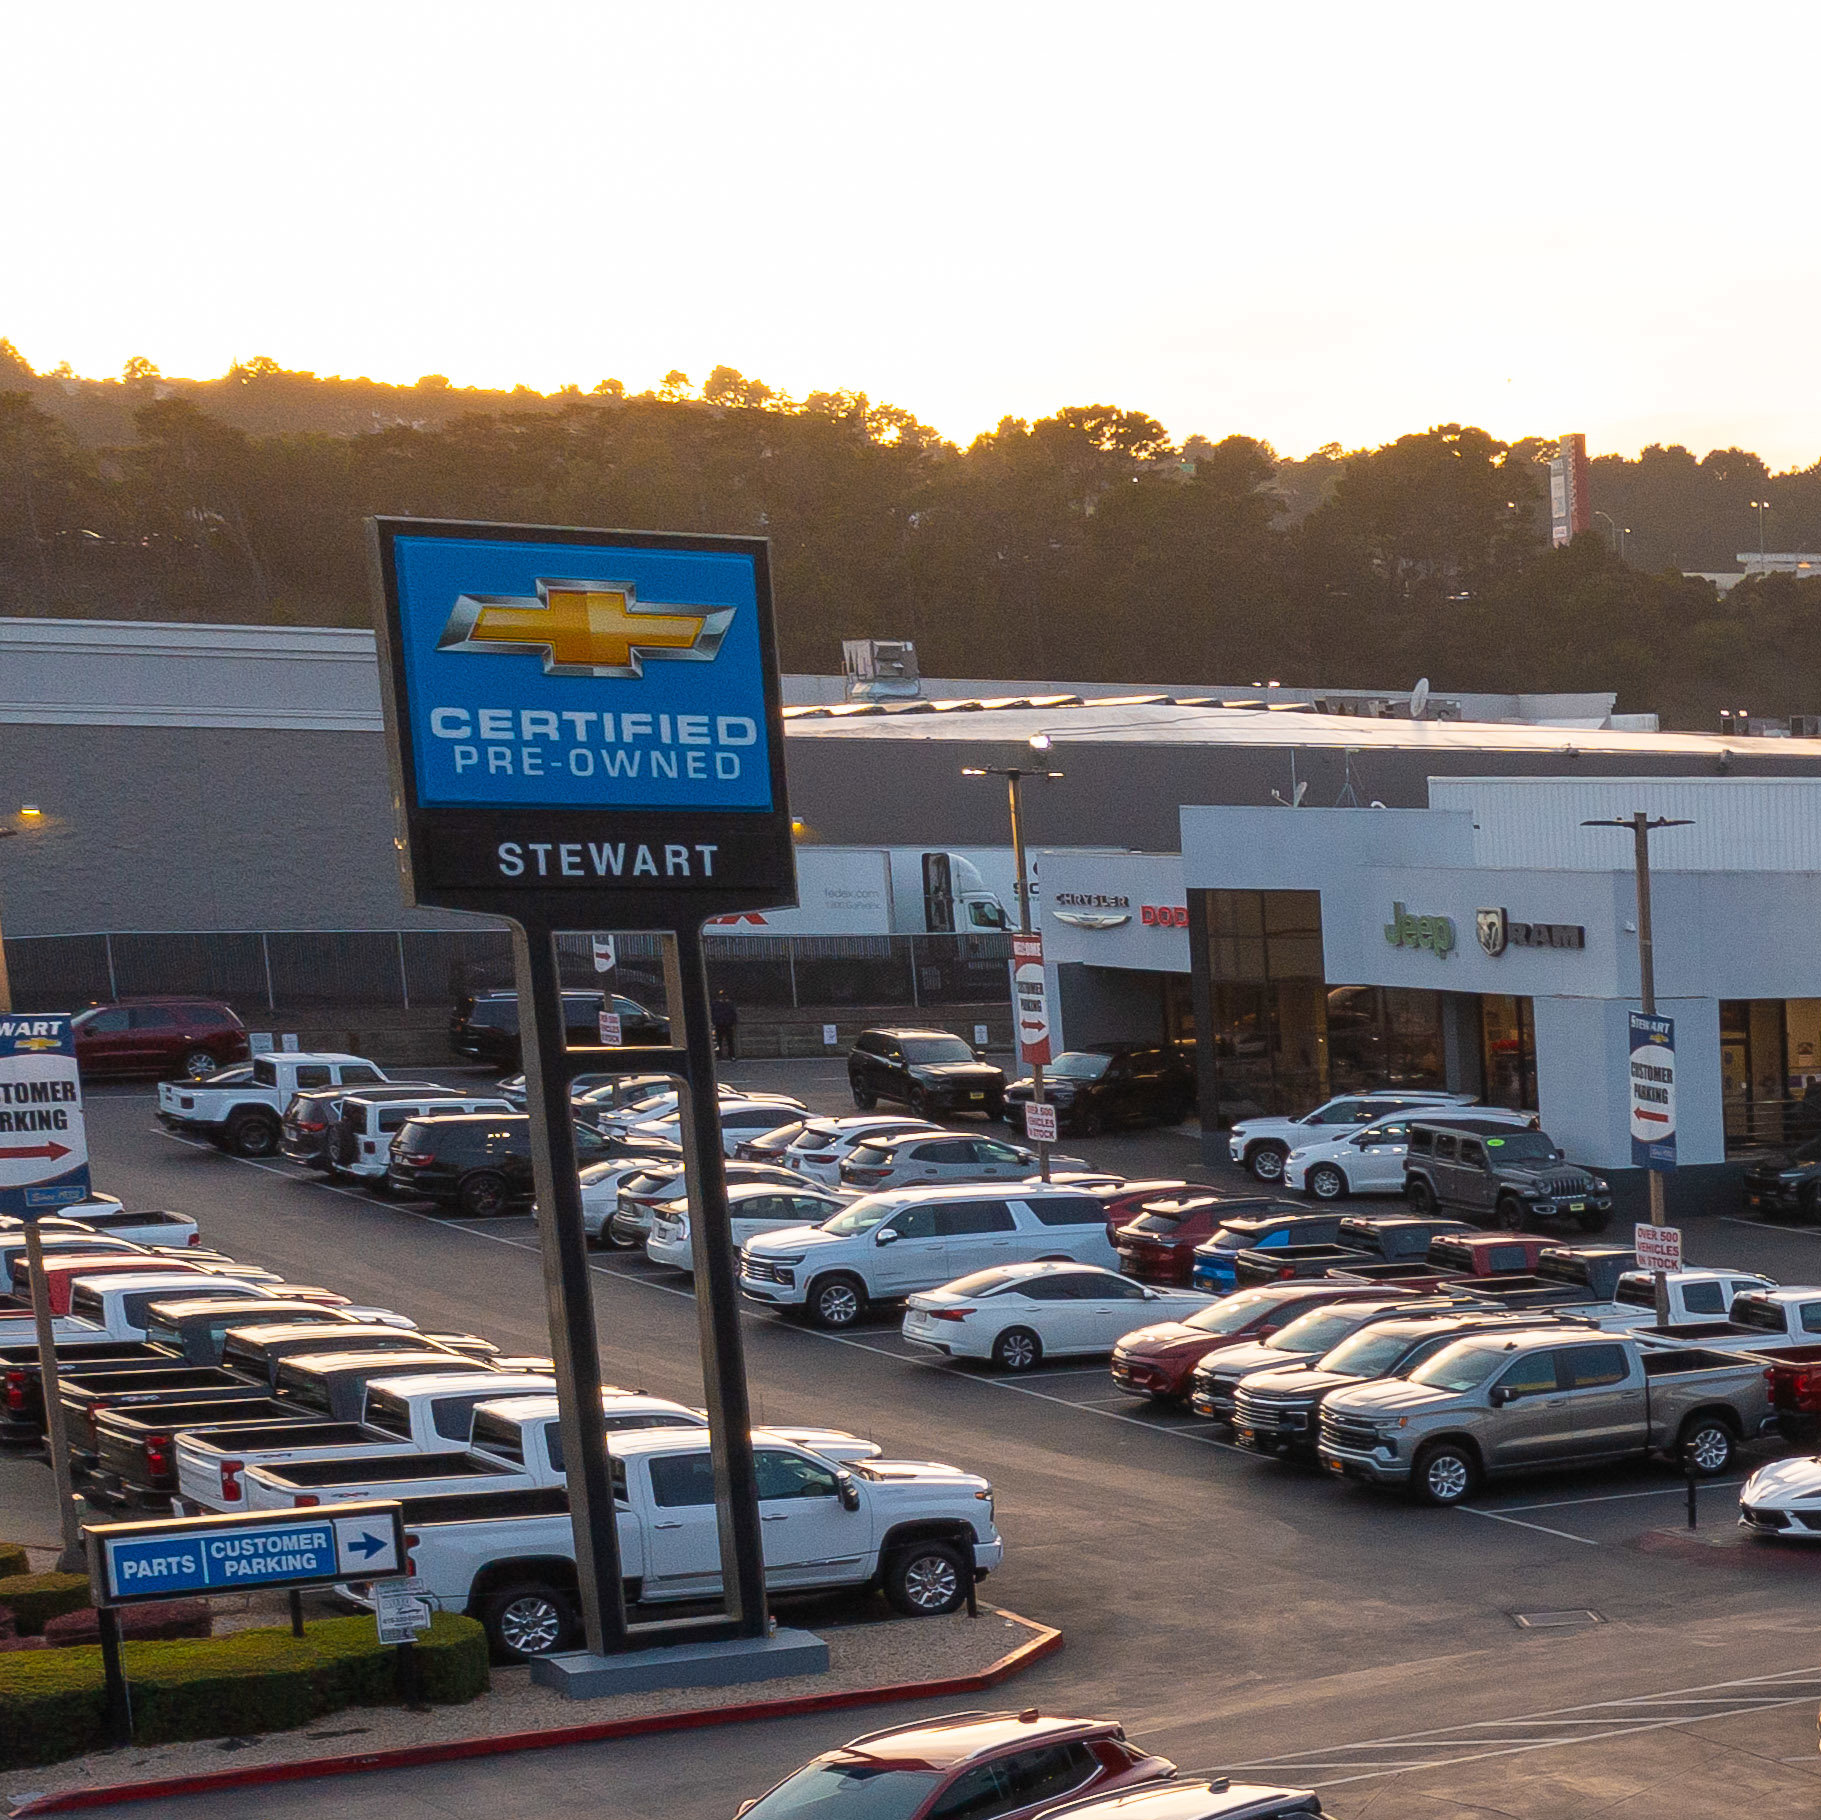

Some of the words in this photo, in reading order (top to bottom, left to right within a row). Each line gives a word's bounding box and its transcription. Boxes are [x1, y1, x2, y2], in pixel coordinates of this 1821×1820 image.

[430, 706, 758, 747] CERTIFIED
[453, 745, 741, 780] PRE-OWNED
[498, 841, 719, 877] STEWART
[1055, 893, 1130, 908] CHRYSLER
[1384, 901, 1456, 959] Jeep
[1507, 922, 1586, 949] RAM
[1631, 1061, 1673, 1085] CUSTOMER
[0, 1081, 77, 1104] TOMER
[1634, 1083, 1669, 1105] PARKING
[1637, 1241, 1680, 1257] VEHICLES
[1660, 1231, 1679, 1243] 500
[1647, 1256, 1679, 1270] STOCK
[211, 1532, 327, 1559] CUSTOMER
[122, 1555, 197, 1580] PARTS
[224, 1552, 318, 1577] PARKING
